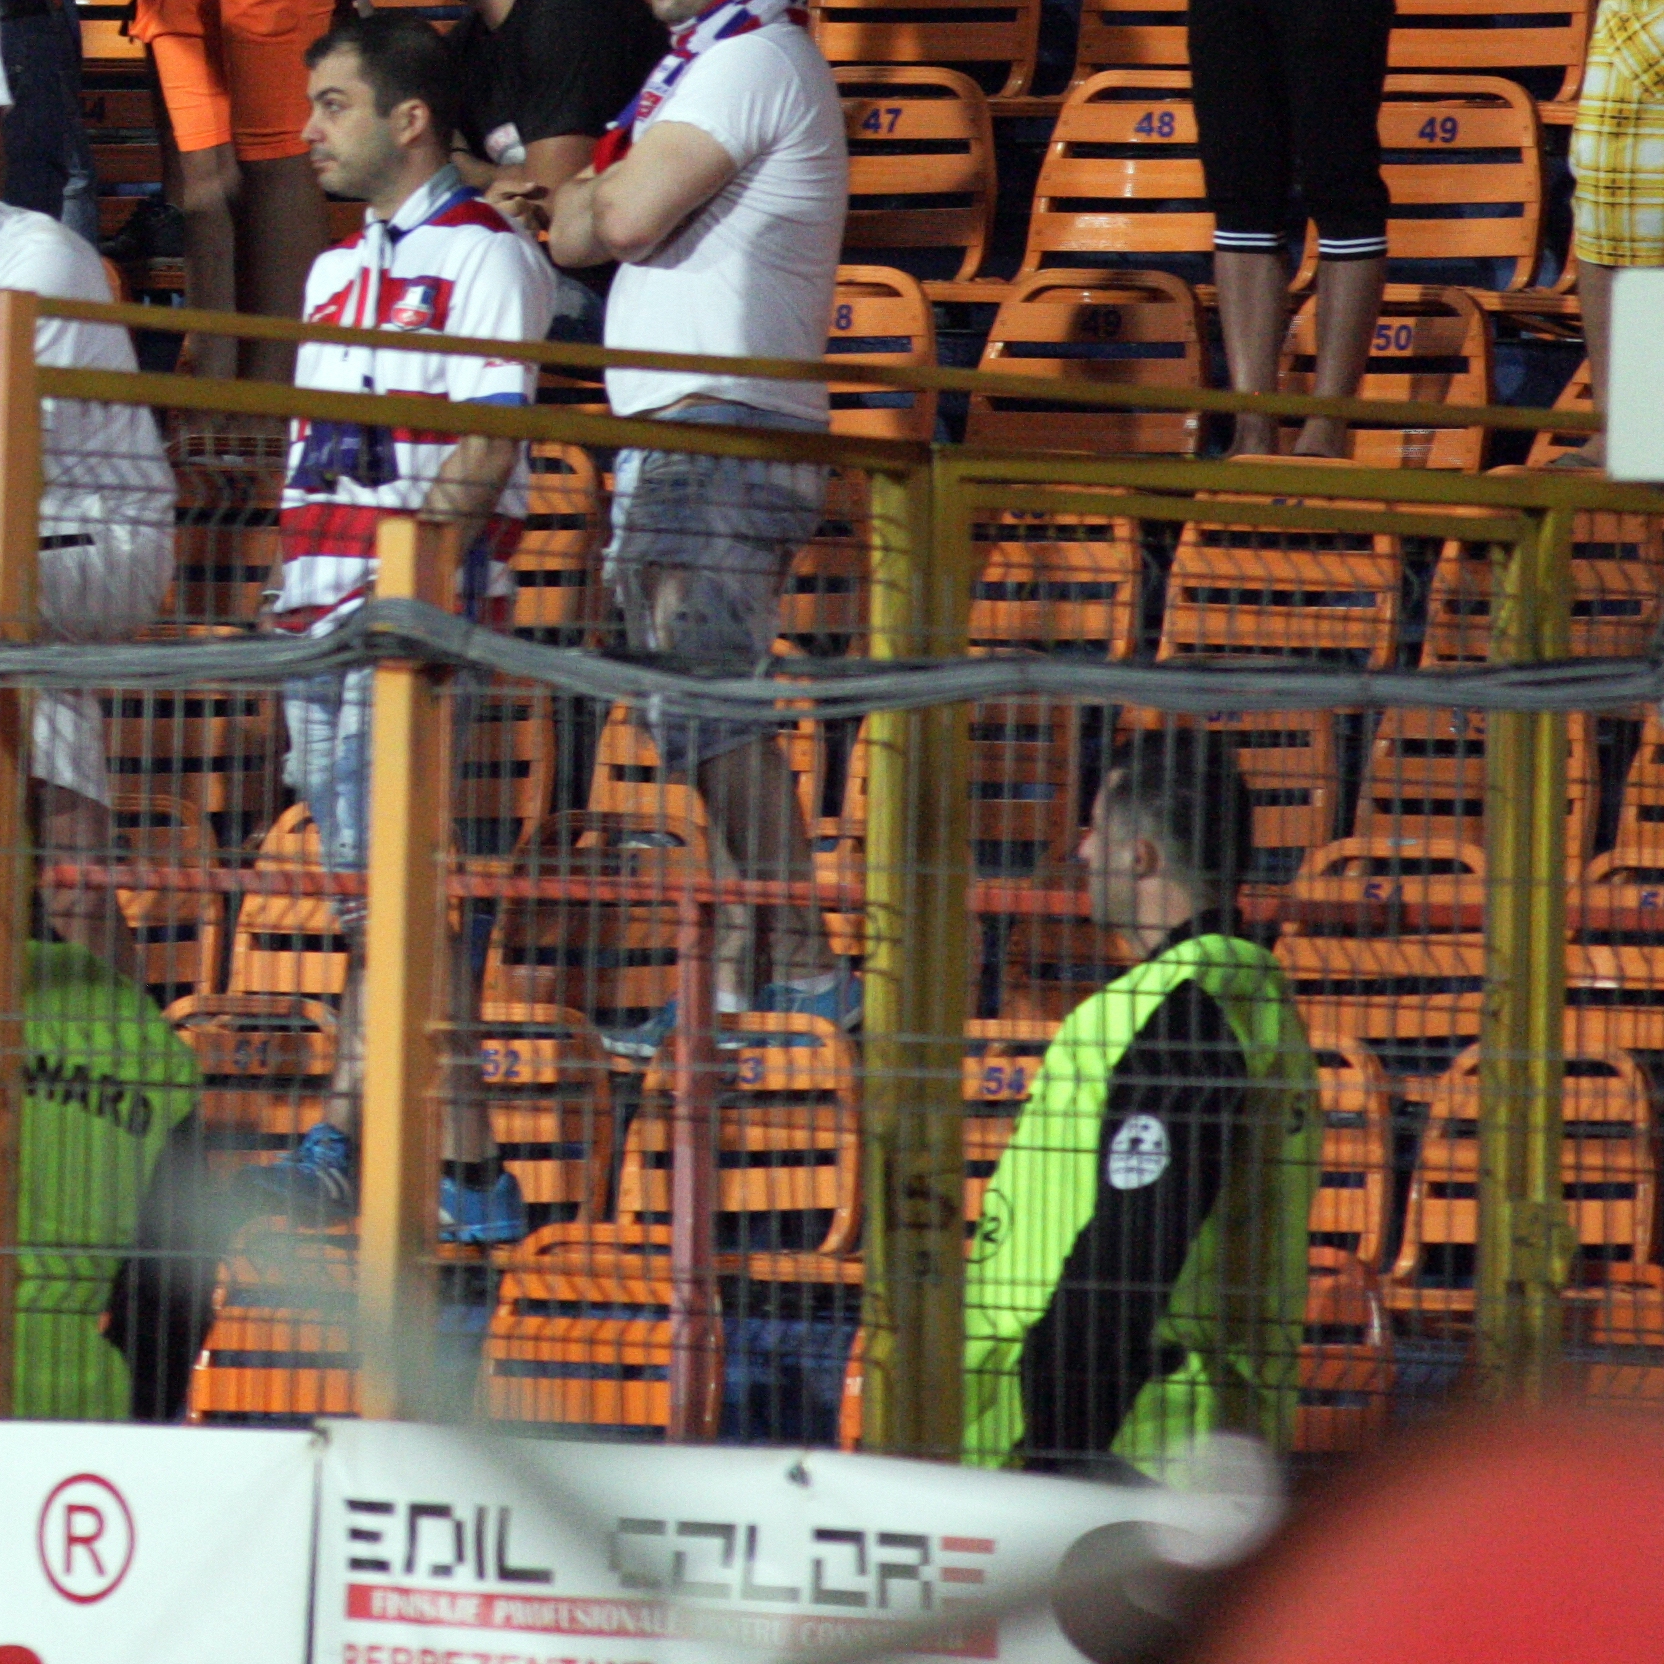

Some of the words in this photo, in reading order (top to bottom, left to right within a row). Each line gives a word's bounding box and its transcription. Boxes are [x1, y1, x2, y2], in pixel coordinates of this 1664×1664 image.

[859, 108, 901, 133] 47
[1133, 111, 1174, 139] 48
[1416, 117, 1458, 144] 49
[1374, 325, 1412, 351] 50
[480, 1048, 520, 1078] 52
